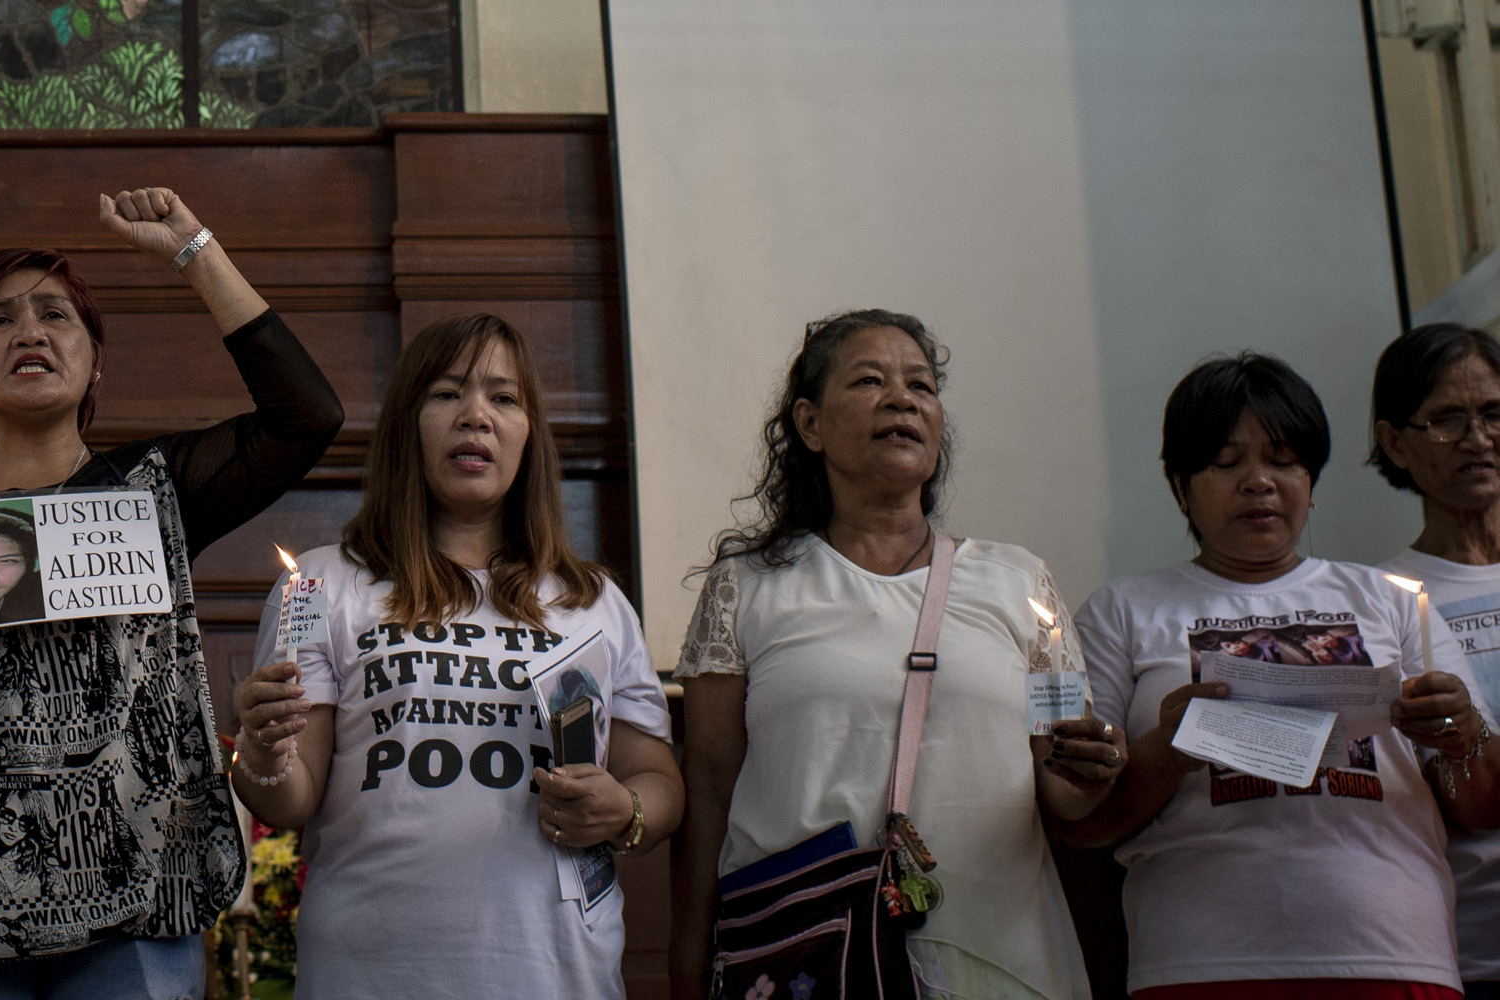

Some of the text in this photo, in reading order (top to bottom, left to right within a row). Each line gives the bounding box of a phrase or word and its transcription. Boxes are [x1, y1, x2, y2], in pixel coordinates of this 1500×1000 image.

[38, 498, 151, 527] JUSTICE
[71, 530, 127, 547] FOR
[48, 550, 157, 581] ALDRIN
[48, 583, 164, 611] CASTILLO
[180, 572, 193, 601] TRUE
[294, 596, 312, 604] THE
[1187, 609, 1357, 634] JUSTICE FOR
[357, 620, 569, 658] STOP TH
[371, 697, 523, 736] AGAINST
[10, 728, 61, 746] WALK
[1210, 773, 1279, 806] ANGELITO
[1326, 767, 1384, 801] SORIANO
[28, 906, 83, 926] WALK
